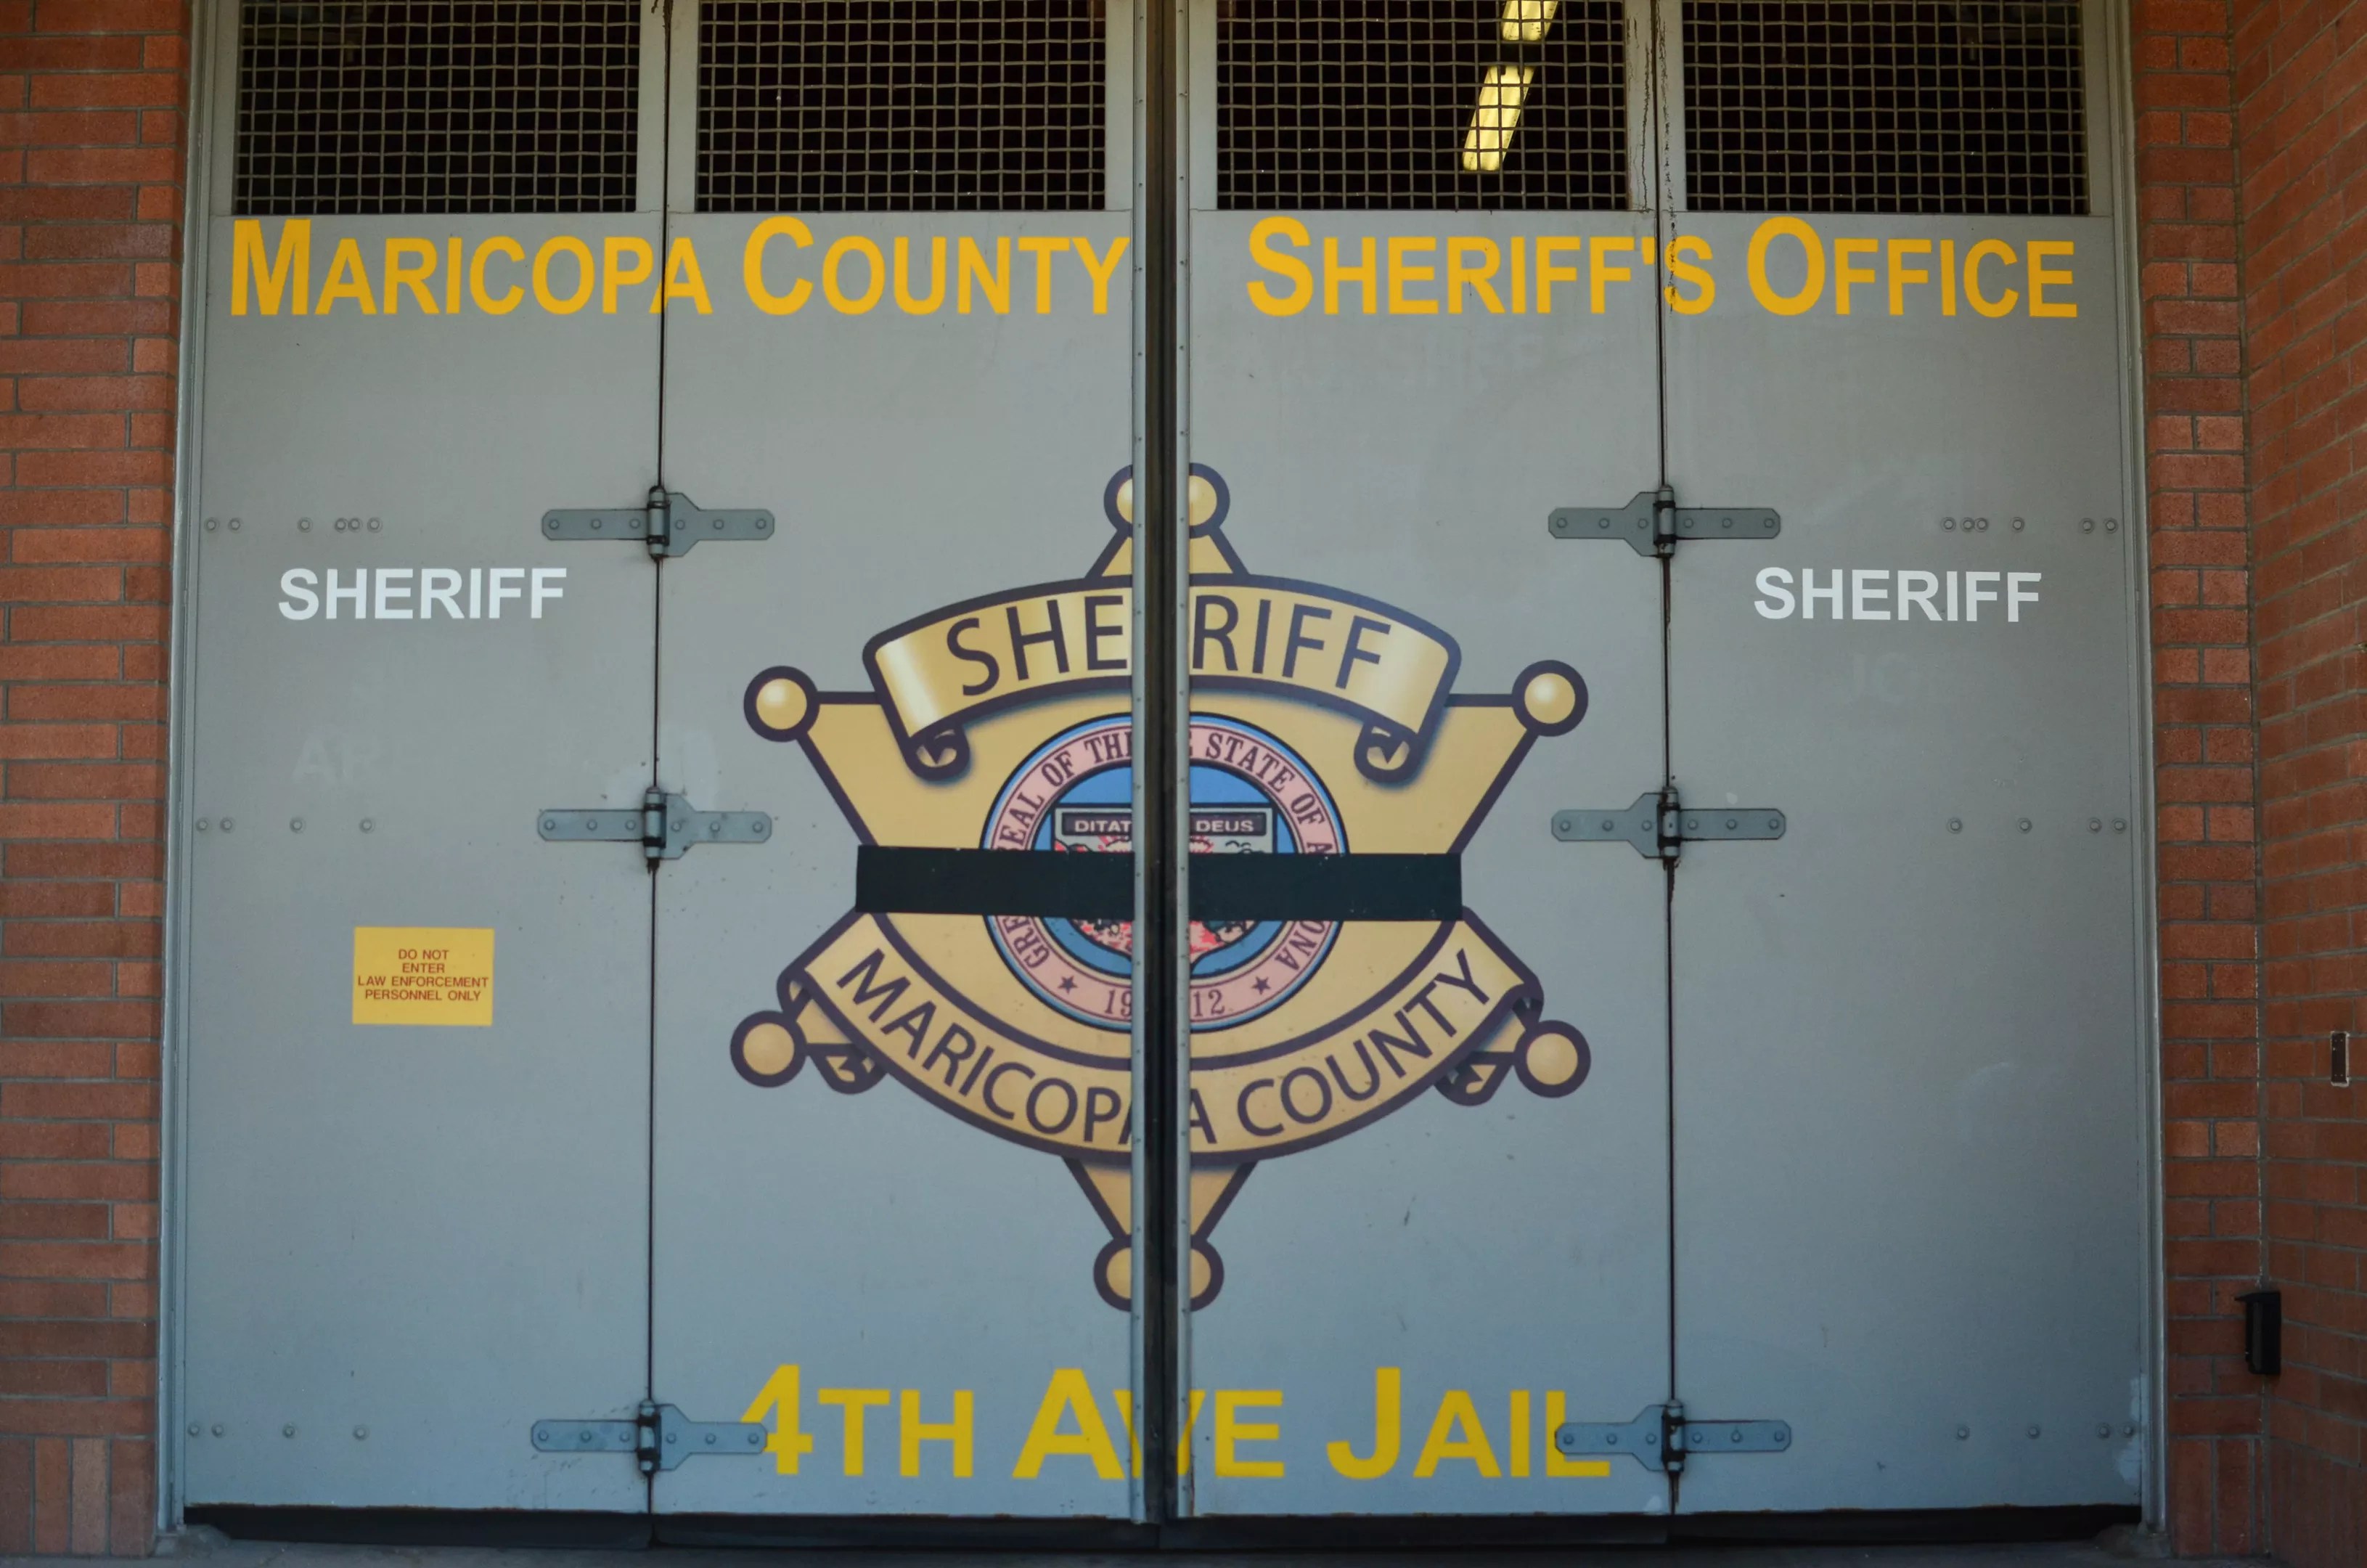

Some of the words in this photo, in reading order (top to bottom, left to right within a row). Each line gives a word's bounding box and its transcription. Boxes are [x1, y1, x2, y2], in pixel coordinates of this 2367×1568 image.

[231, 219, 713, 316] MARICOPA
[743, 216, 1130, 315] COUNTY
[1246, 216, 1715, 317] SHERIFF'S
[1747, 216, 2078, 317] OFFICE
[279, 568, 567, 620] SHERIFF
[1754, 567, 2042, 622] SHERIFF
[946, 595, 1391, 697] SHERIFF
[997, 791, 1045, 850] EAL
[1041, 750, 1076, 787] OF
[1206, 732, 1296, 793] STATE
[1291, 793, 1325, 825] OF
[1075, 820, 1132, 832] DITAT
[1196, 820, 1254, 832] DEUS
[398, 949, 417, 960] DO
[422, 950, 449, 960] NOT
[402, 963, 445, 973] ENTER
[358, 976, 386, 986] LAW
[392, 976, 488, 987] ENFORCEMENT
[365, 989, 442, 1000] PERSONNEL
[448, 990, 481, 1001] ONLY
[836, 948, 1217, 1145] MARICOPA
[1237, 949, 1489, 1137] COUNTY
[740, 1363, 973, 1478] 4TH
[1326, 1367, 1610, 1479] JAIL
